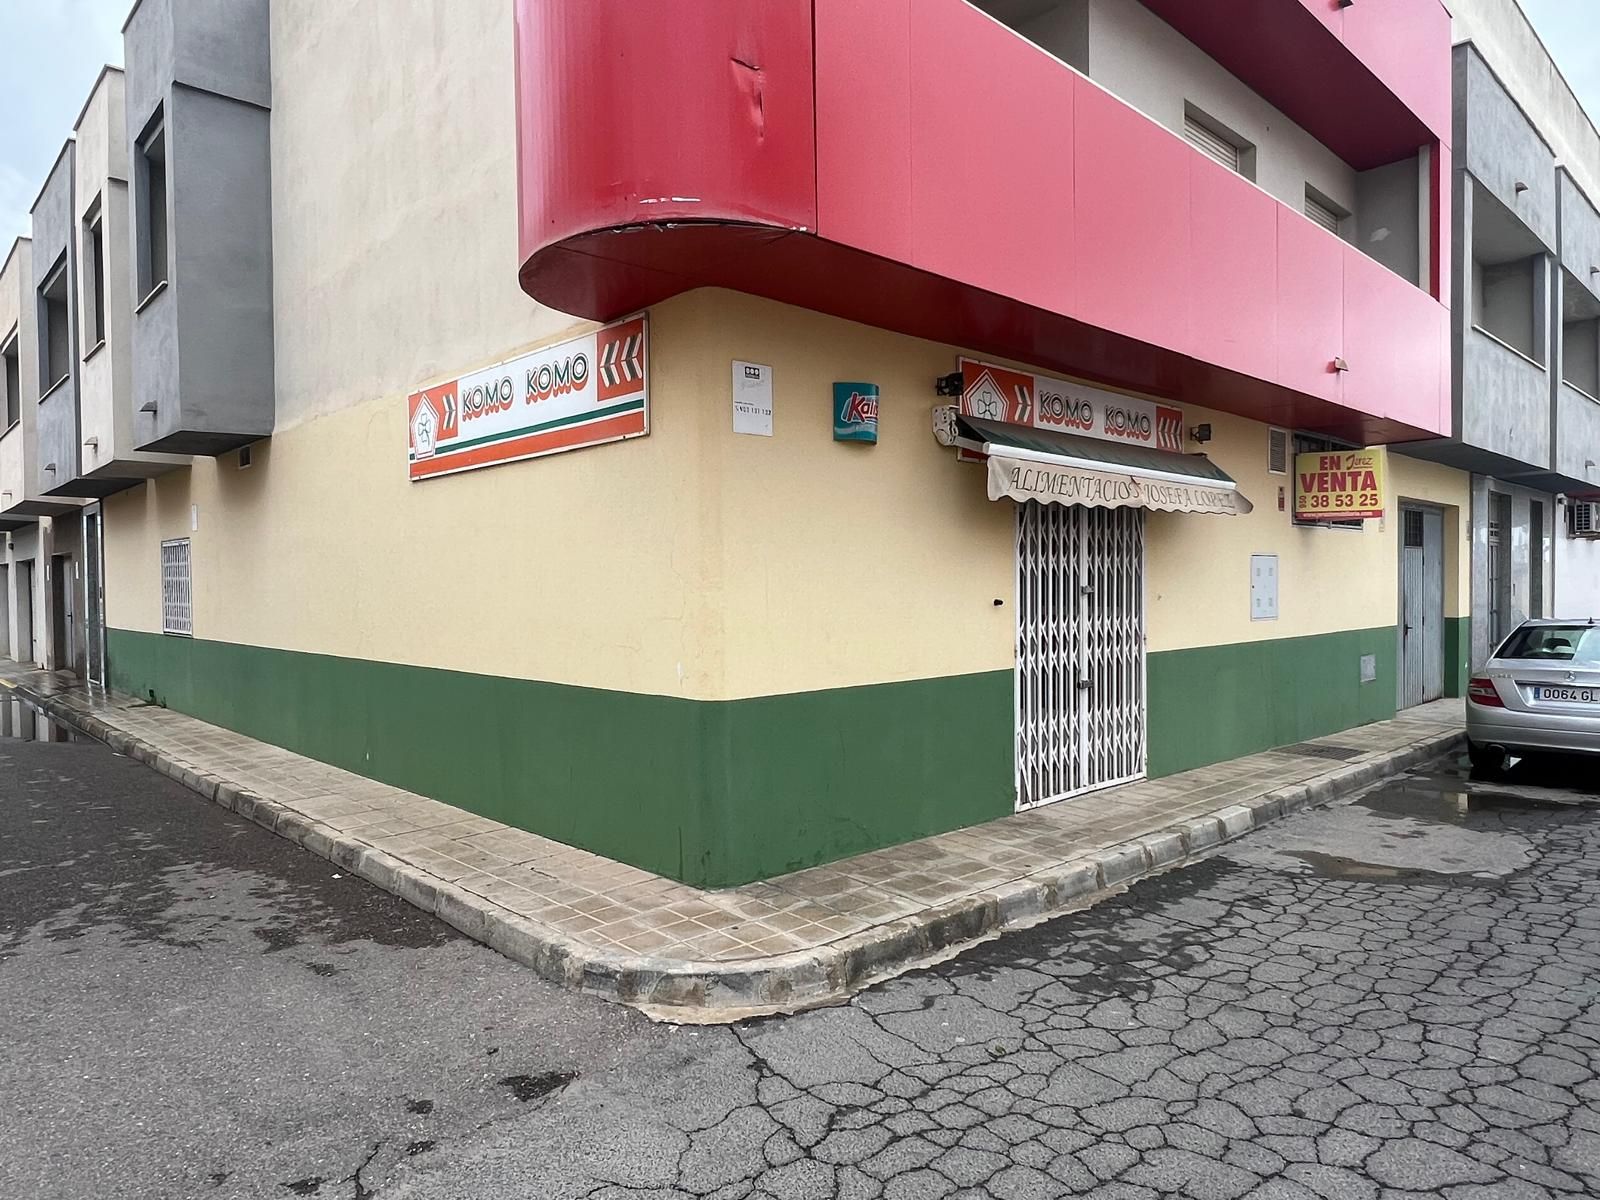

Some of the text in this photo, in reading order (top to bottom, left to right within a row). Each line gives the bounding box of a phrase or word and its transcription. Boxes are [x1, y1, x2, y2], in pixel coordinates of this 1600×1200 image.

[462, 353, 589, 420] KOMO KOMO
[1039, 390, 1152, 441] KOMO KOMO
[1319, 455, 1341, 471] EN
[1300, 470, 1378, 493] VENTA
[1143, 483, 1193, 508] JOSEFA
[1310, 494, 1330, 508] 38
[1335, 494, 1354, 507] 53
[1359, 493, 1379, 507] 25
[1543, 688, 1577, 700] 0064
